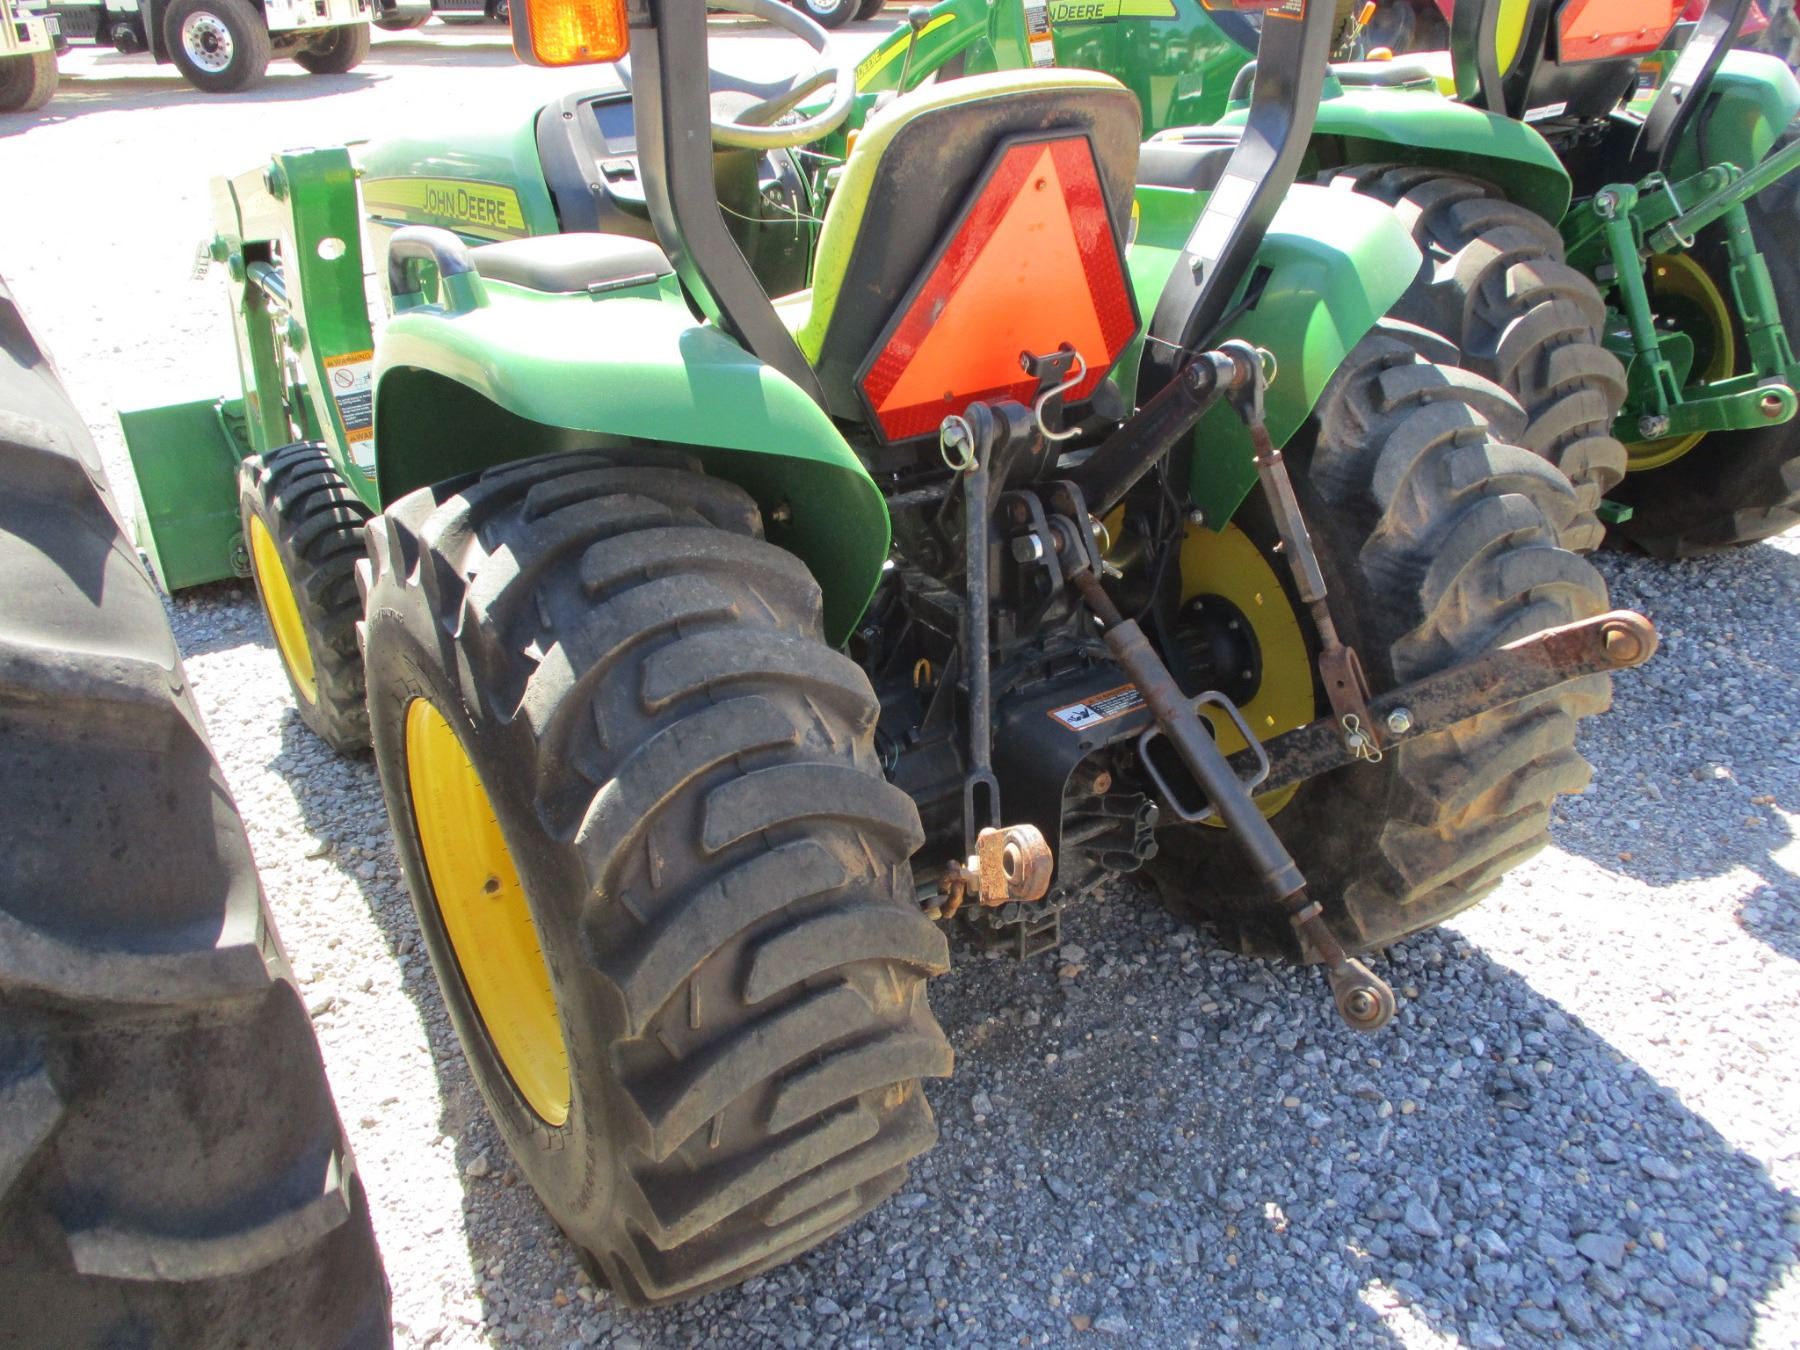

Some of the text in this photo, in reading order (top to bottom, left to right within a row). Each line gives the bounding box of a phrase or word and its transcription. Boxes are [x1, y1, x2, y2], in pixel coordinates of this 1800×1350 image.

[1059, 4, 1104, 20] DEERE
[423, 184, 505, 224] JOHN DEERE
